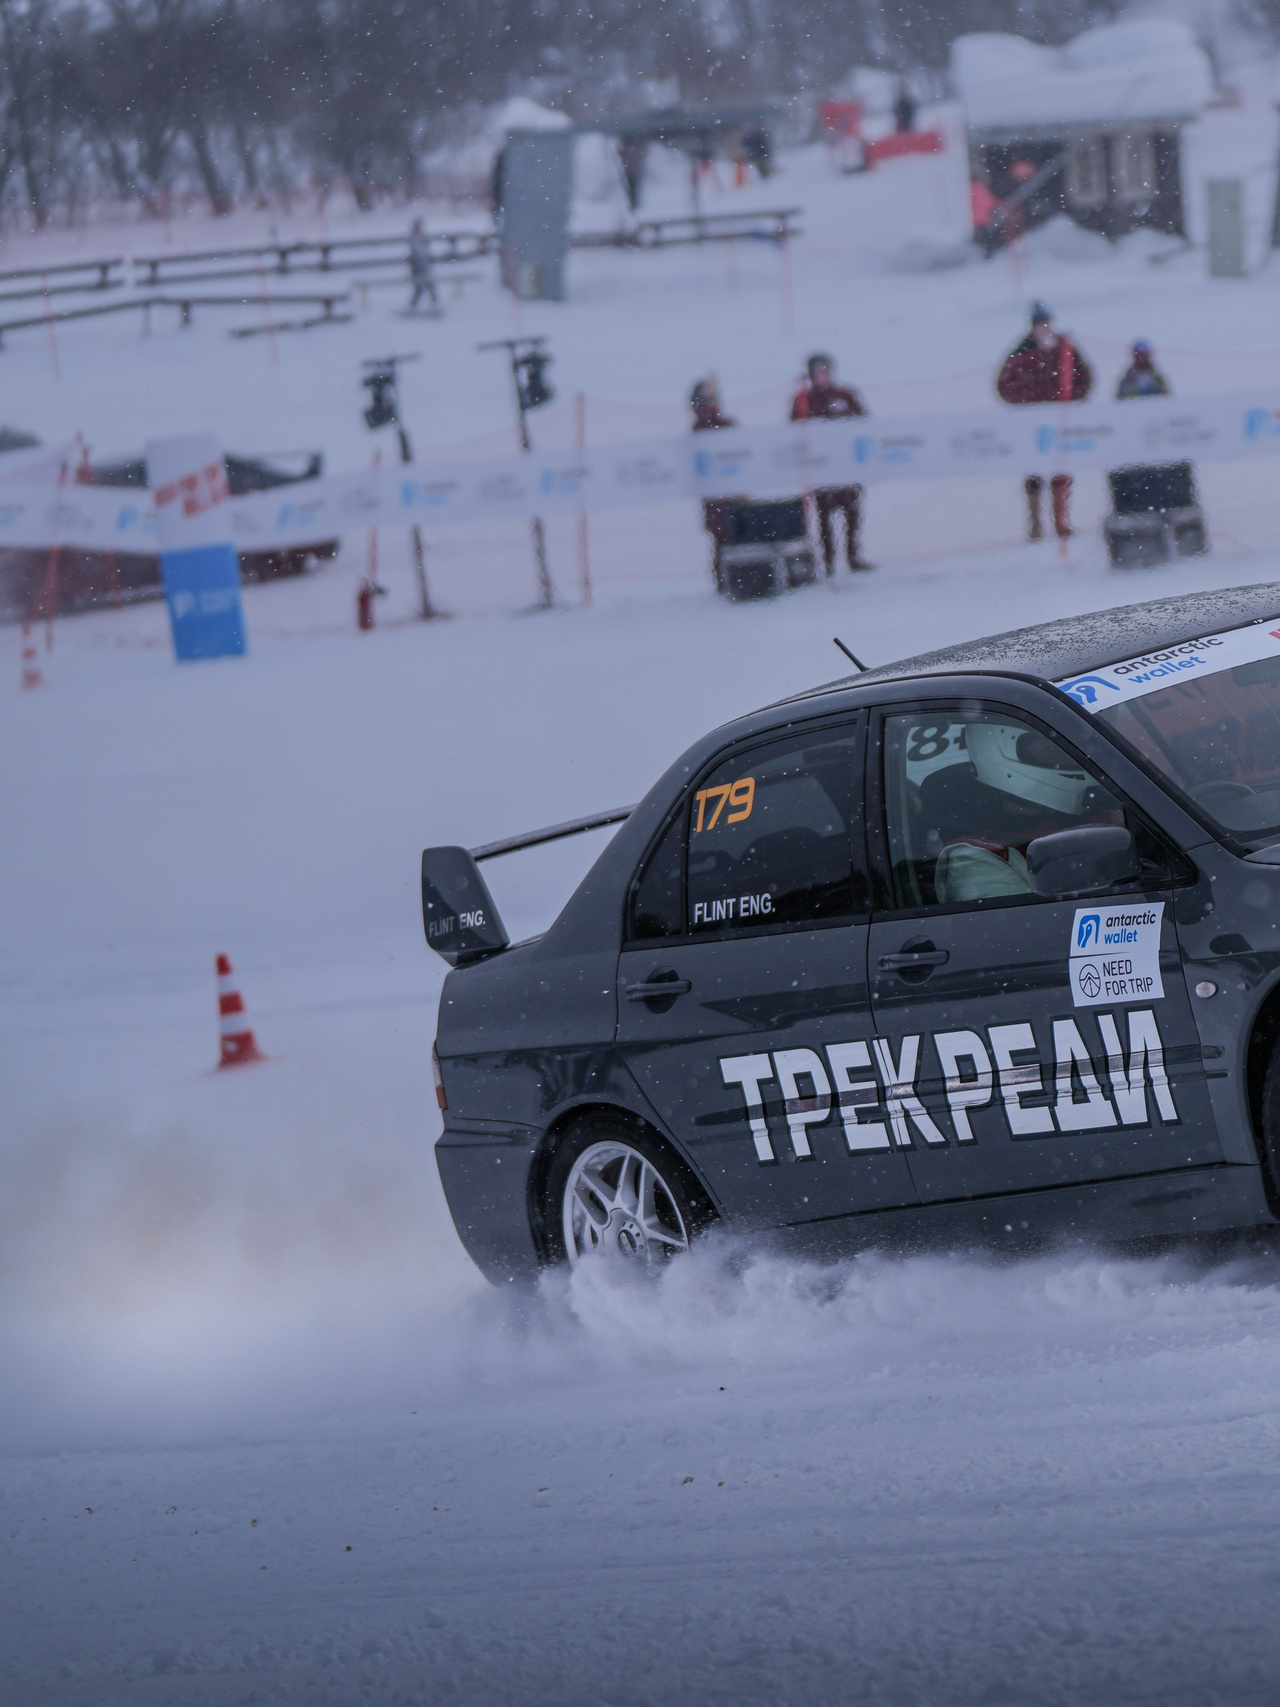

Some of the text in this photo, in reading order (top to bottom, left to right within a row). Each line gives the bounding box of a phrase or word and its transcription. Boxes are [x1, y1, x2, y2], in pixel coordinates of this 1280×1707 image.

[1113, 637, 1224, 675] antarctic
[1127, 655, 1207, 684] wallet
[694, 892, 776, 924] FLINT ENG.
[1105, 910, 1157, 928] antarctic
[429, 909, 486, 938] FLINT ENG.
[1104, 928, 1138, 944] wallet
[1102, 959, 1133, 977] NEED
[1104, 976, 1154, 997] FOR TRIP
